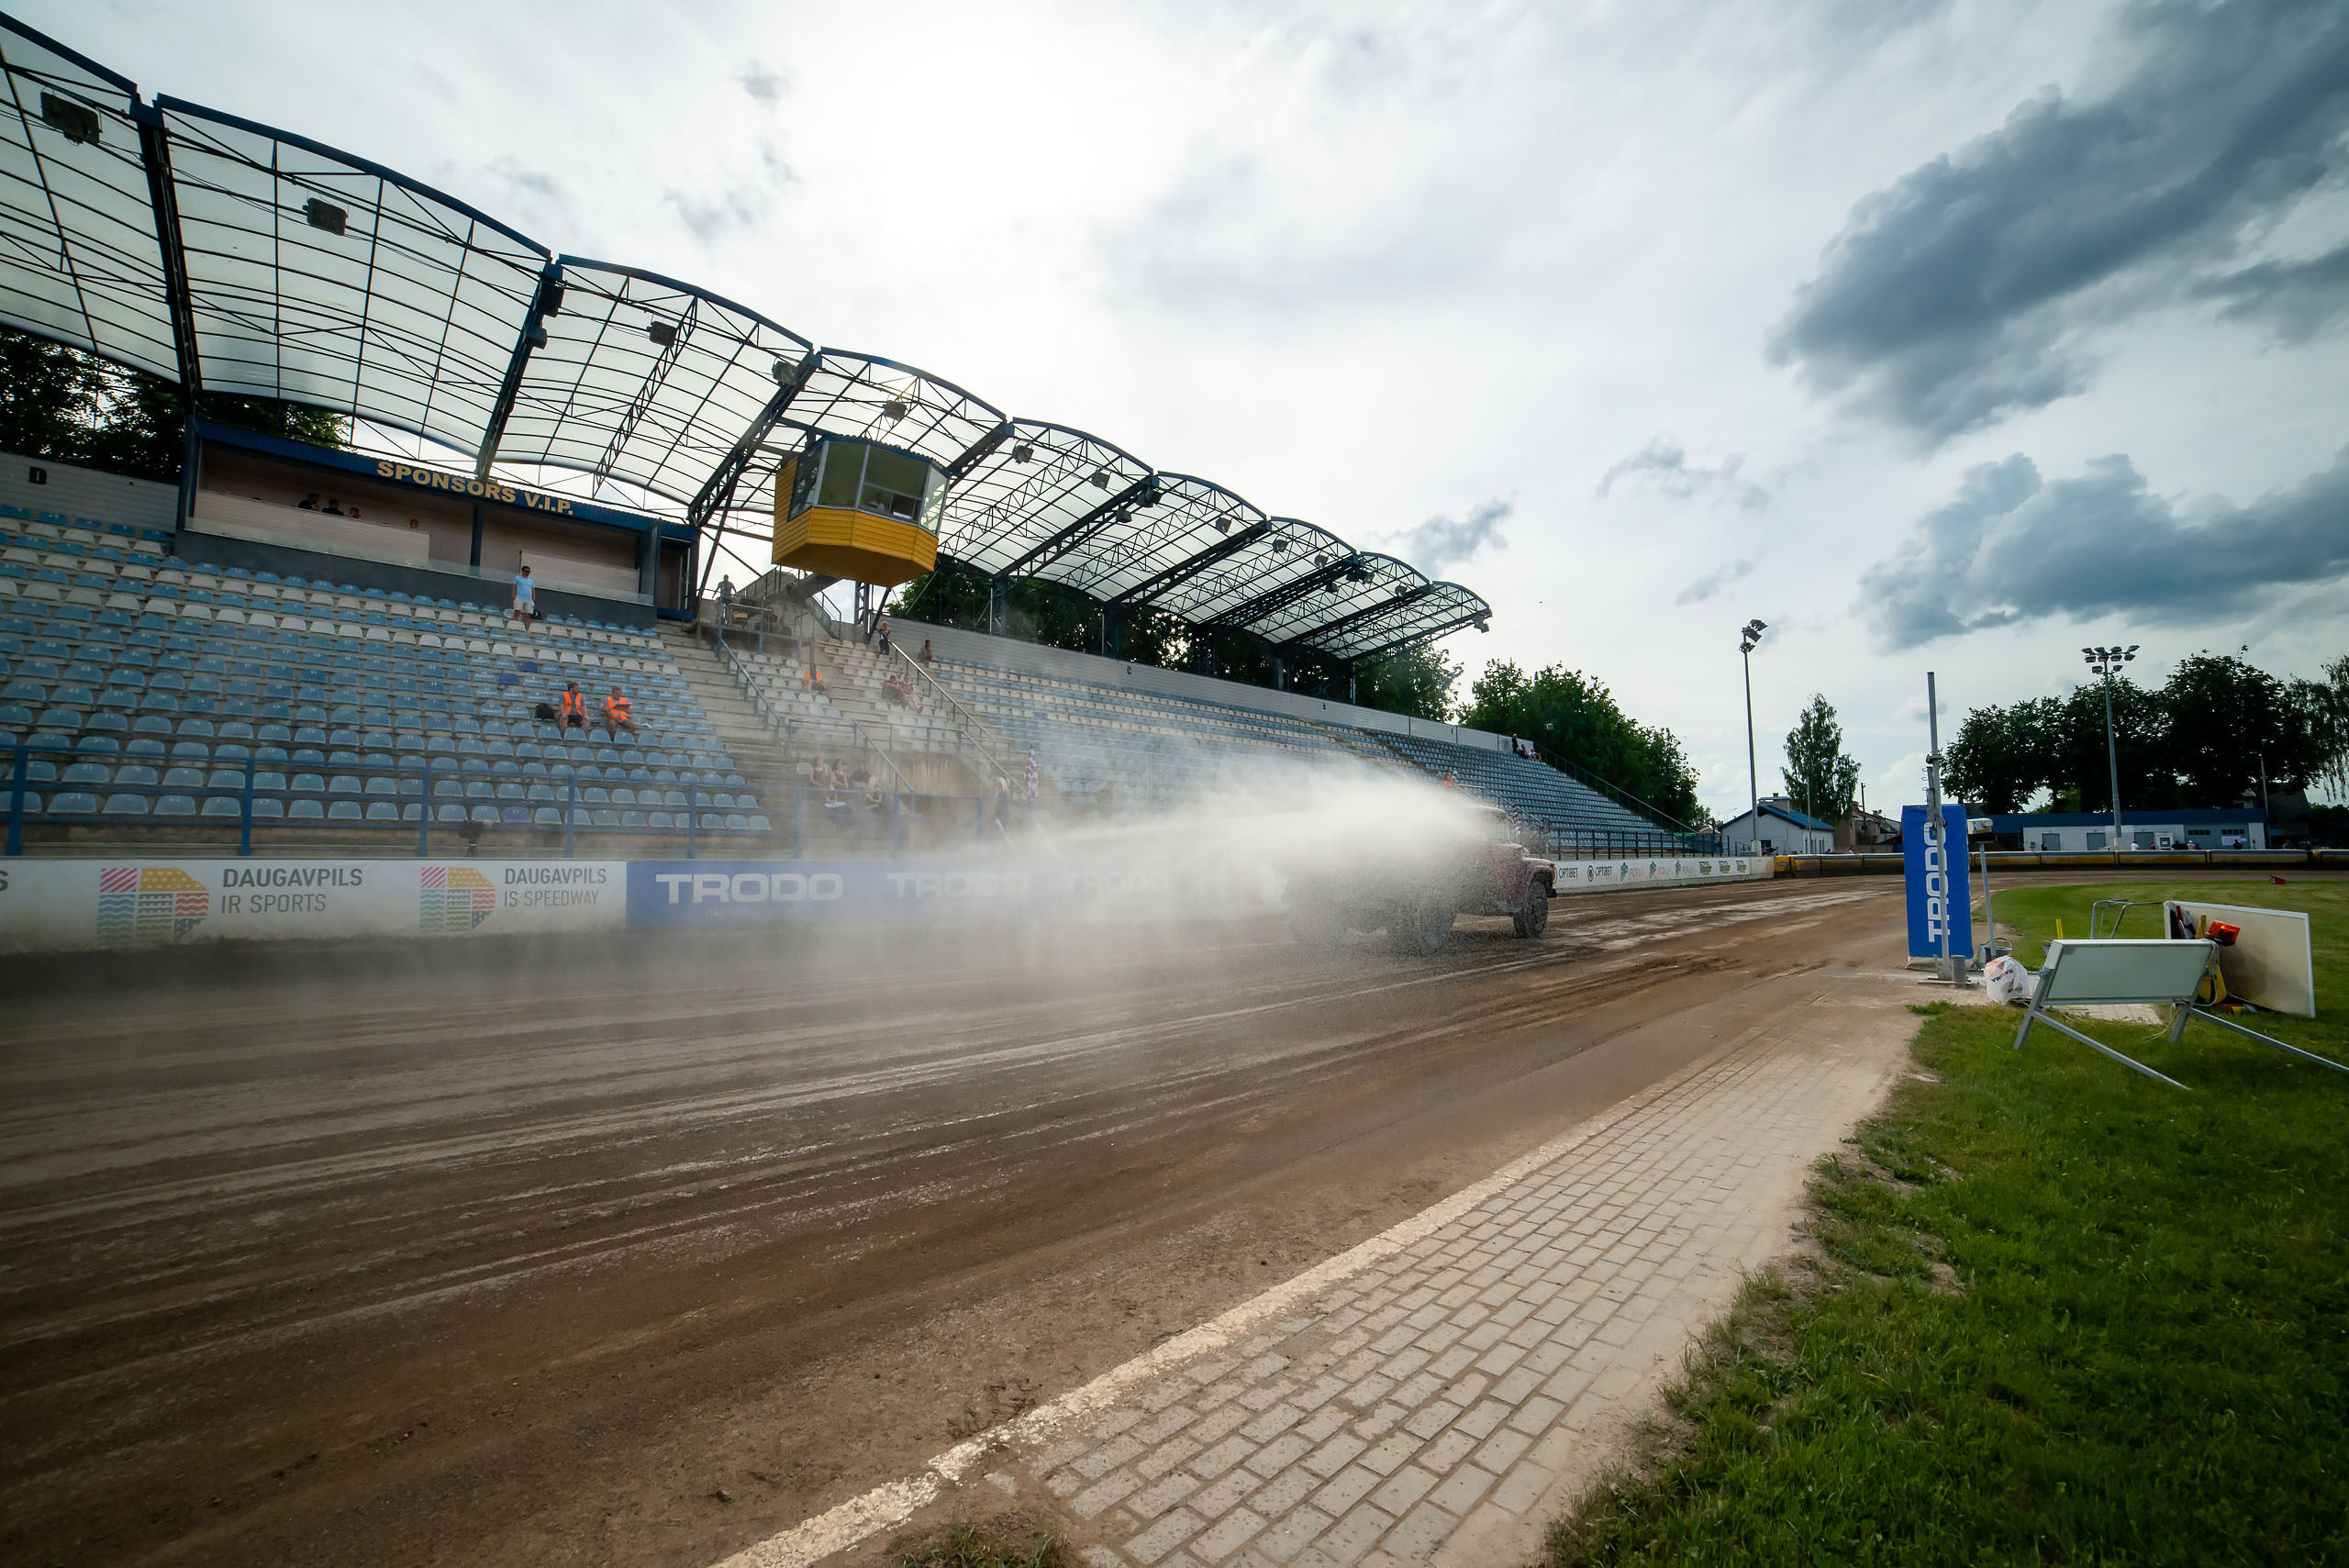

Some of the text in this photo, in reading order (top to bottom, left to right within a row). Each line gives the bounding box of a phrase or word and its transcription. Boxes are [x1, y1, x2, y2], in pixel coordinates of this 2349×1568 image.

[28, 466, 47, 485] D
[376, 461, 573, 516] SPONSORS V.I.P.
[222, 868, 363, 888] DAUGAVPILS
[505, 868, 607, 884] DAUGAVPILS
[1595, 866, 1612, 876] OPTIBET
[655, 873, 843, 904] TRODO
[887, 873, 1029, 899] TRODO
[1923, 822, 1951, 943] TRODO
[221, 894, 327, 914] IR SPORTS
[504, 890, 599, 907] IS SPEEDWAY
